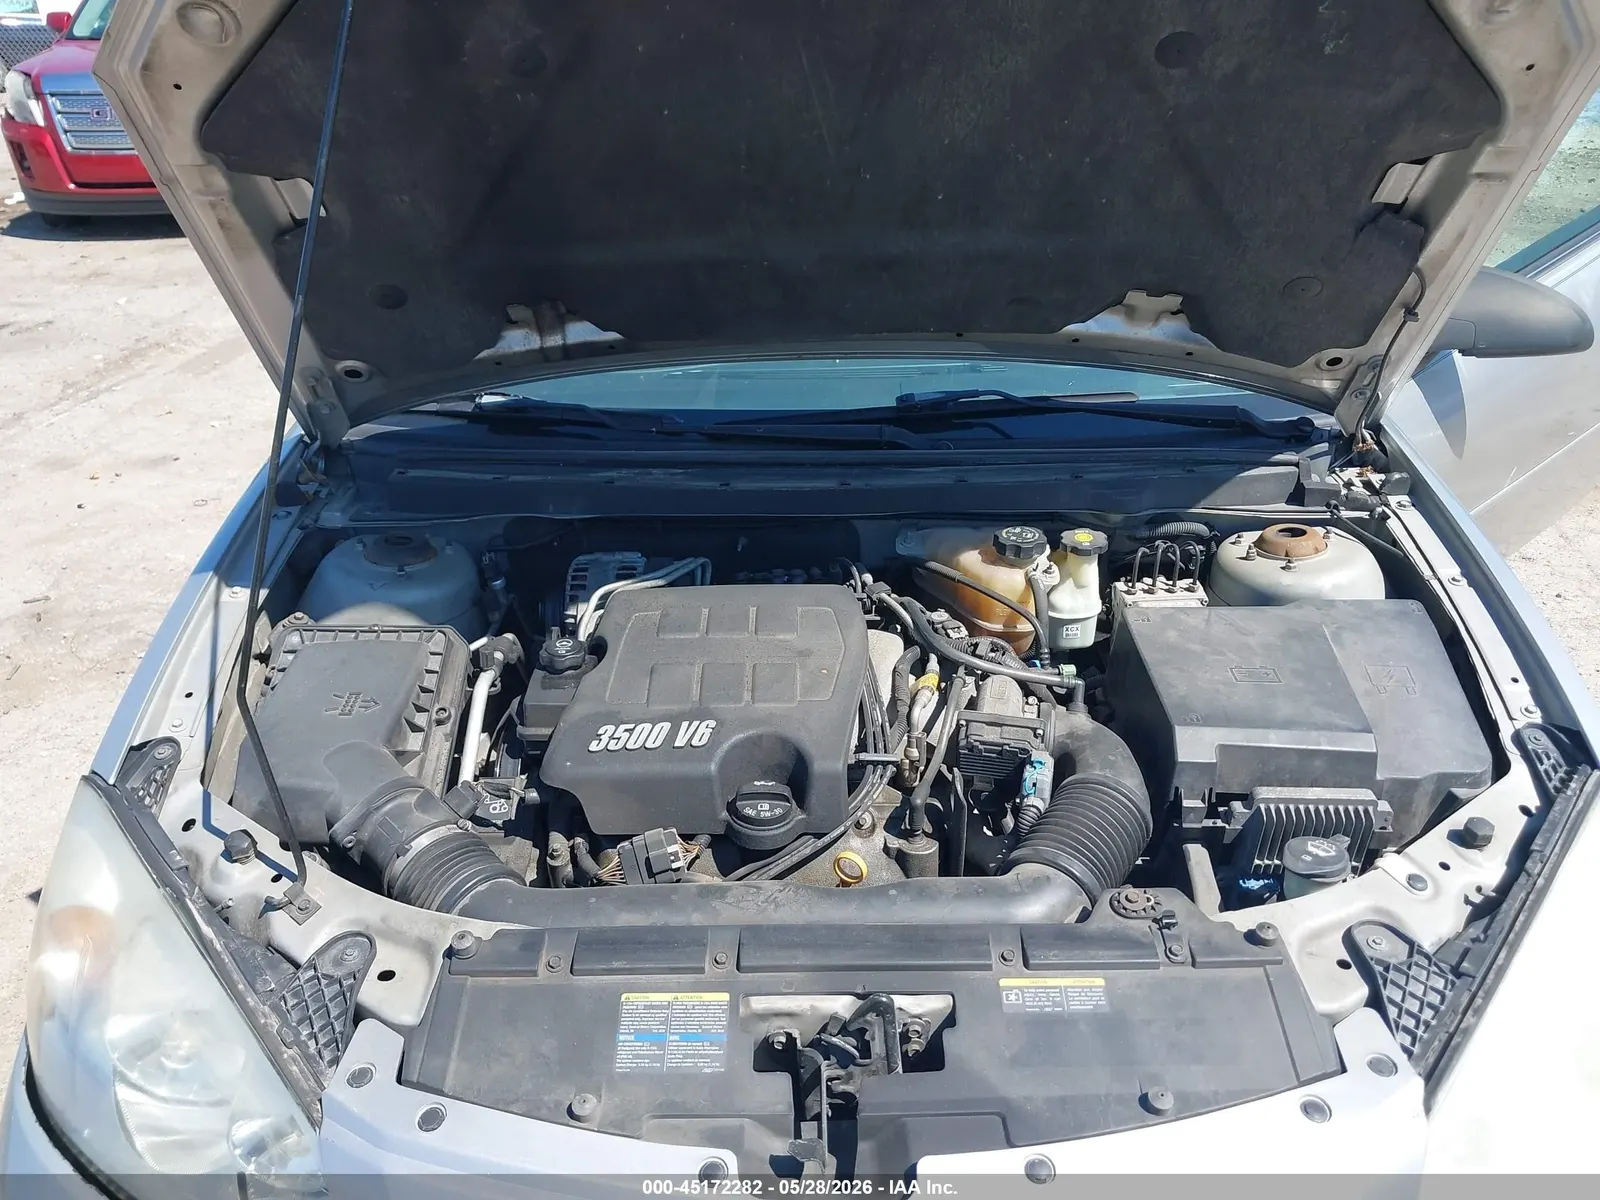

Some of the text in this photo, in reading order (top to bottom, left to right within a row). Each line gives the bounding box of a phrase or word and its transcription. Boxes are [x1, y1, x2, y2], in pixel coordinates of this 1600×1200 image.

[588, 719, 717, 752] 3500 V6
[743, 806, 783, 818] SAE 5W-30
